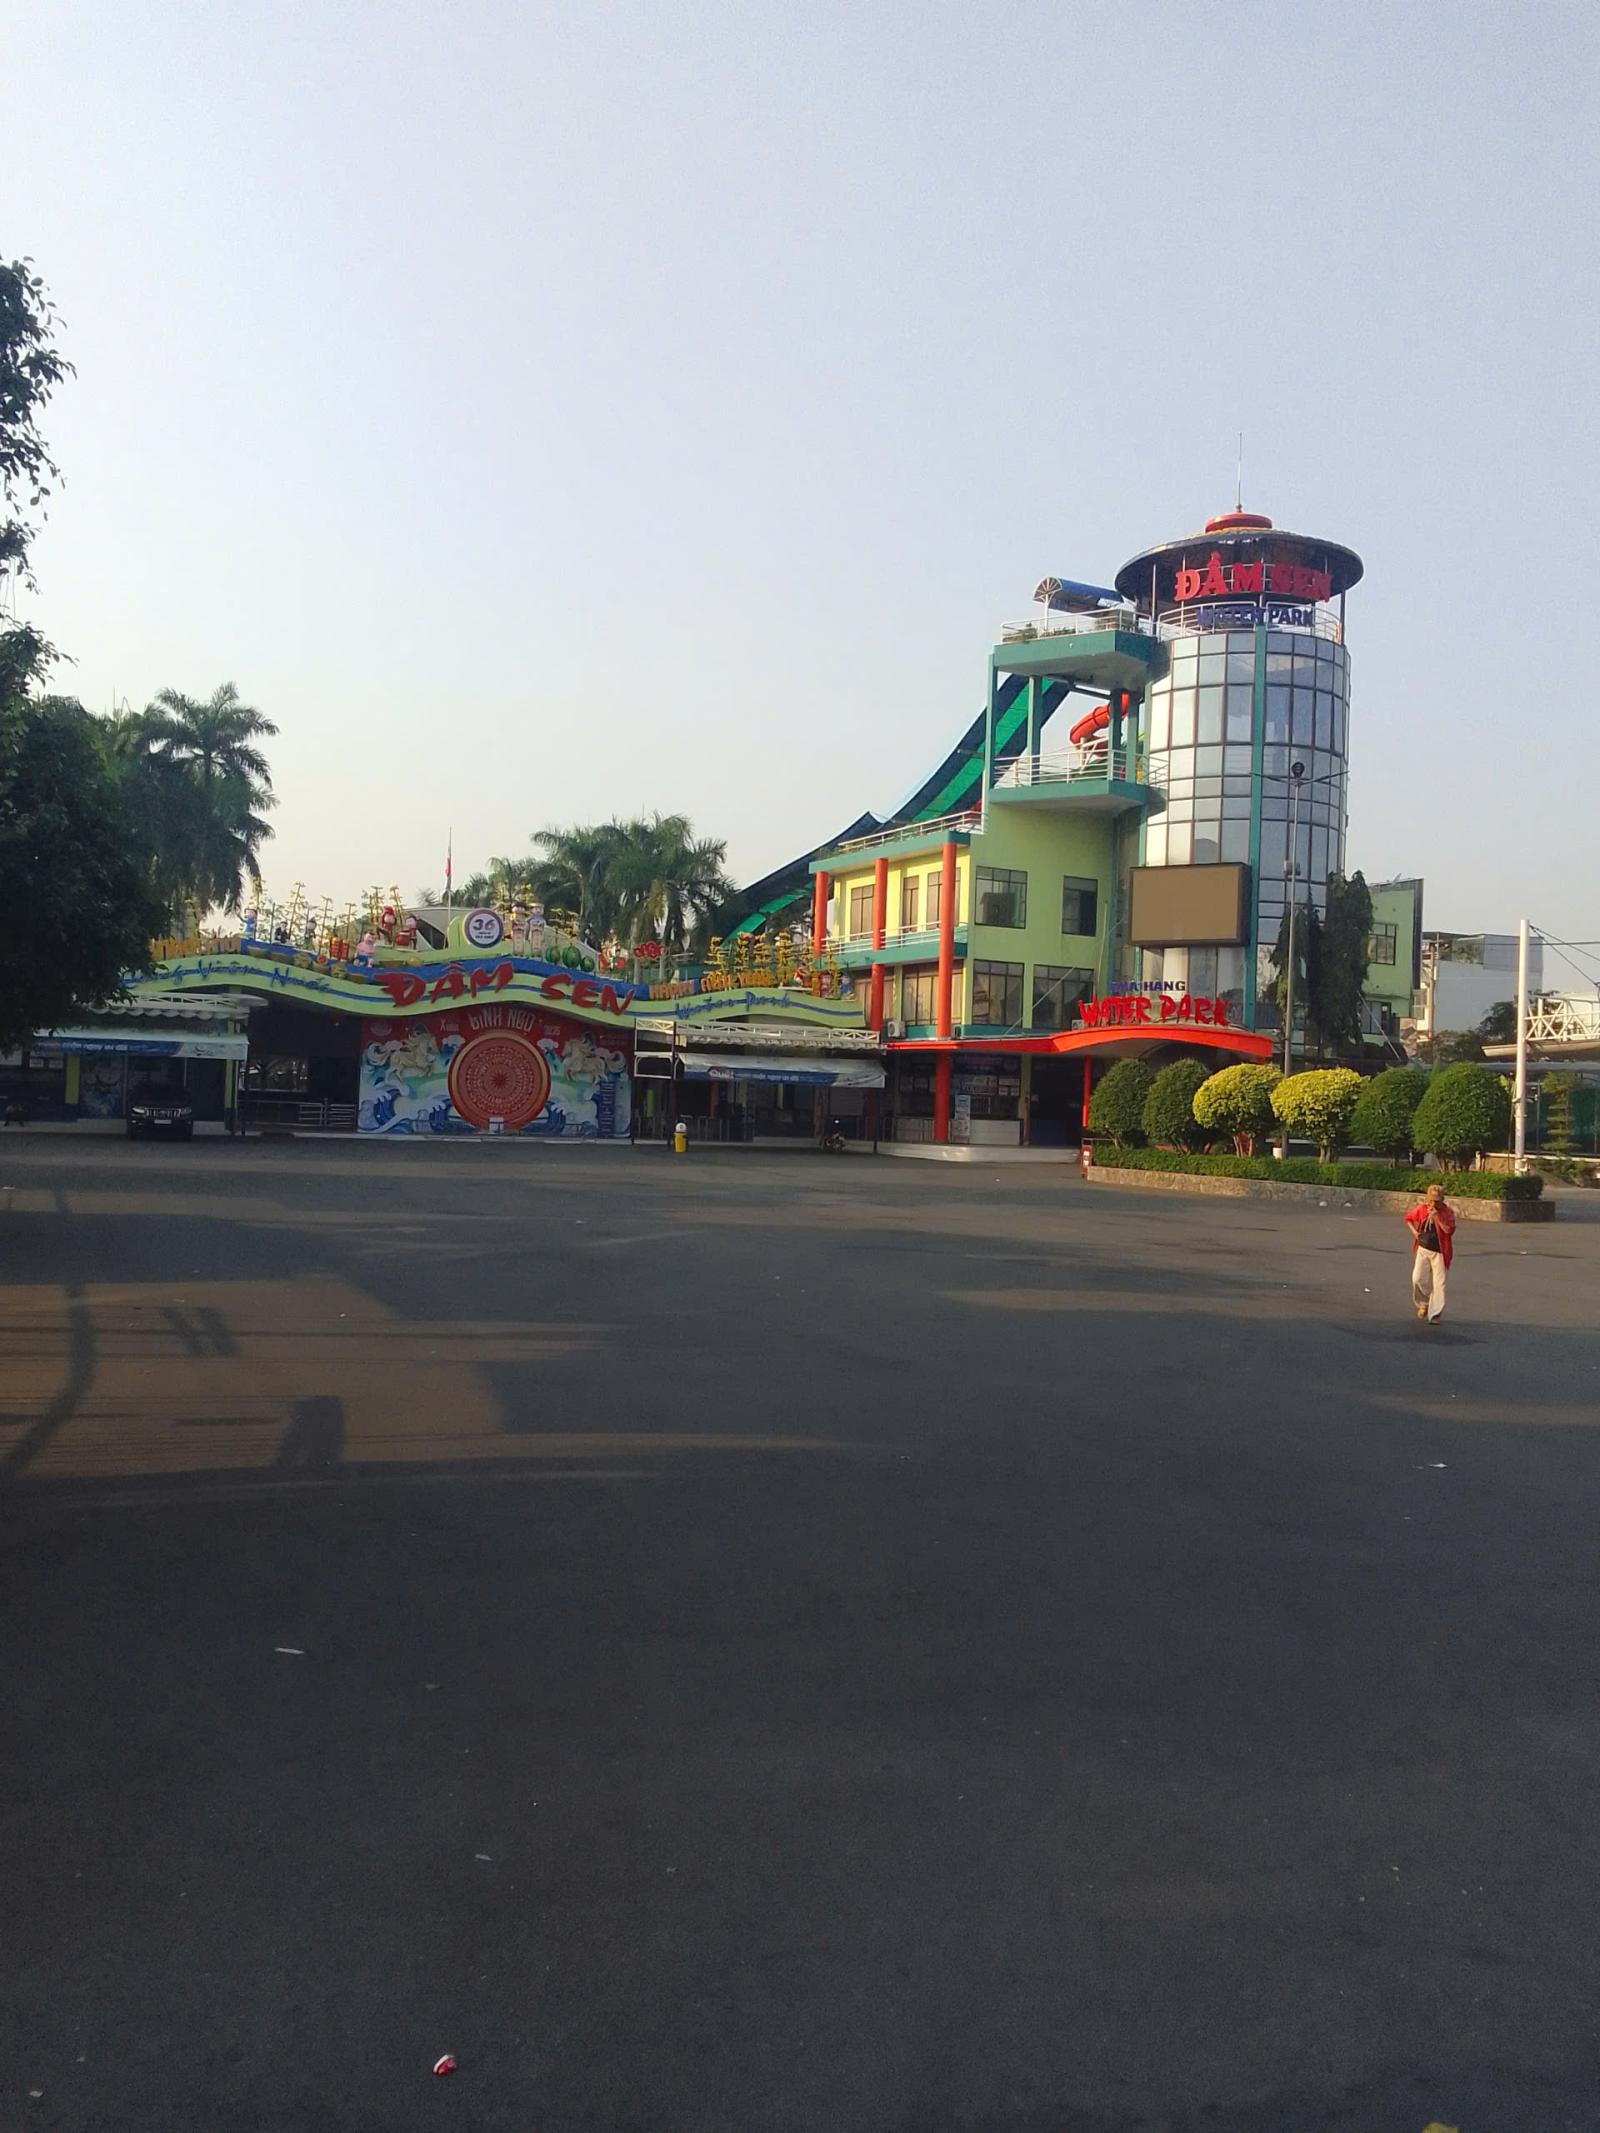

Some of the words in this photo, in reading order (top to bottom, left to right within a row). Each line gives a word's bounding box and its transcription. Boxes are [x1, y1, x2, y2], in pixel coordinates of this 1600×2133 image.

[1270, 562, 1332, 603] SEN
[1268, 604, 1313, 627] PARK
[473, 918, 495, 931] 36
[541, 973, 635, 1016] SEN
[1077, 992, 1152, 1026] WATER
[1158, 993, 1231, 1027] PARK
